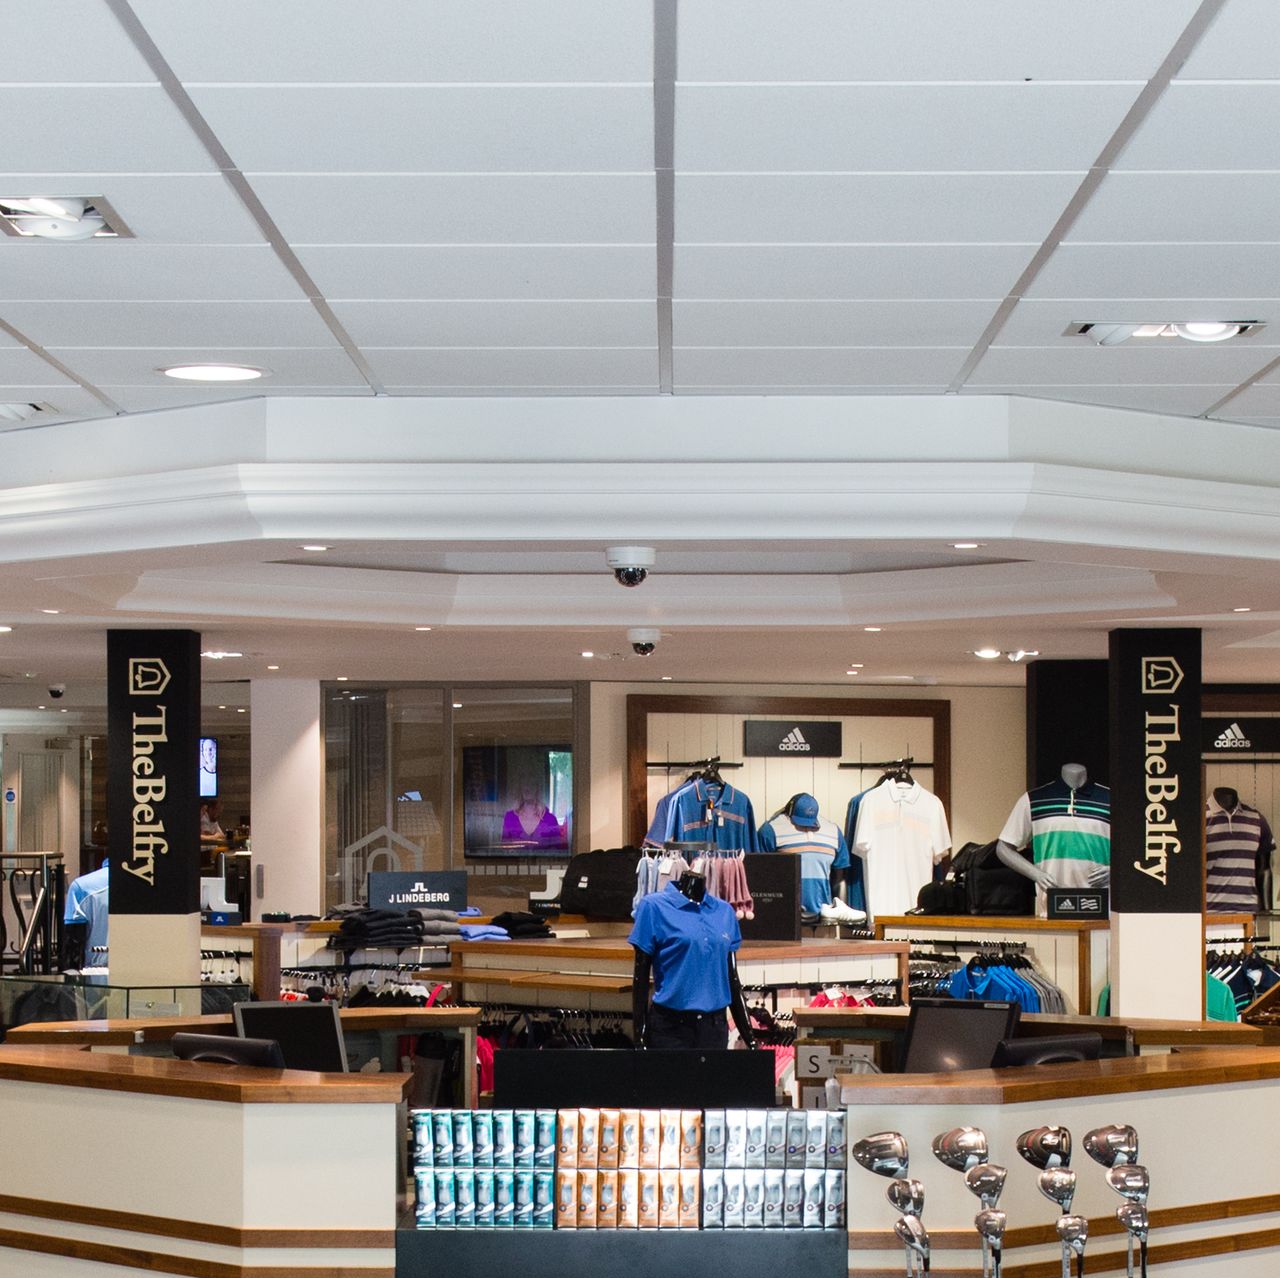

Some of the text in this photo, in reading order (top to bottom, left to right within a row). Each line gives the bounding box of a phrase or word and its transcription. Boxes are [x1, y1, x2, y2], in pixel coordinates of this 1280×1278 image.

[778, 741, 811, 751] adidas
[1214, 738, 1251, 748] adidas
[388, 892, 450, 903] J LINDEBERG
